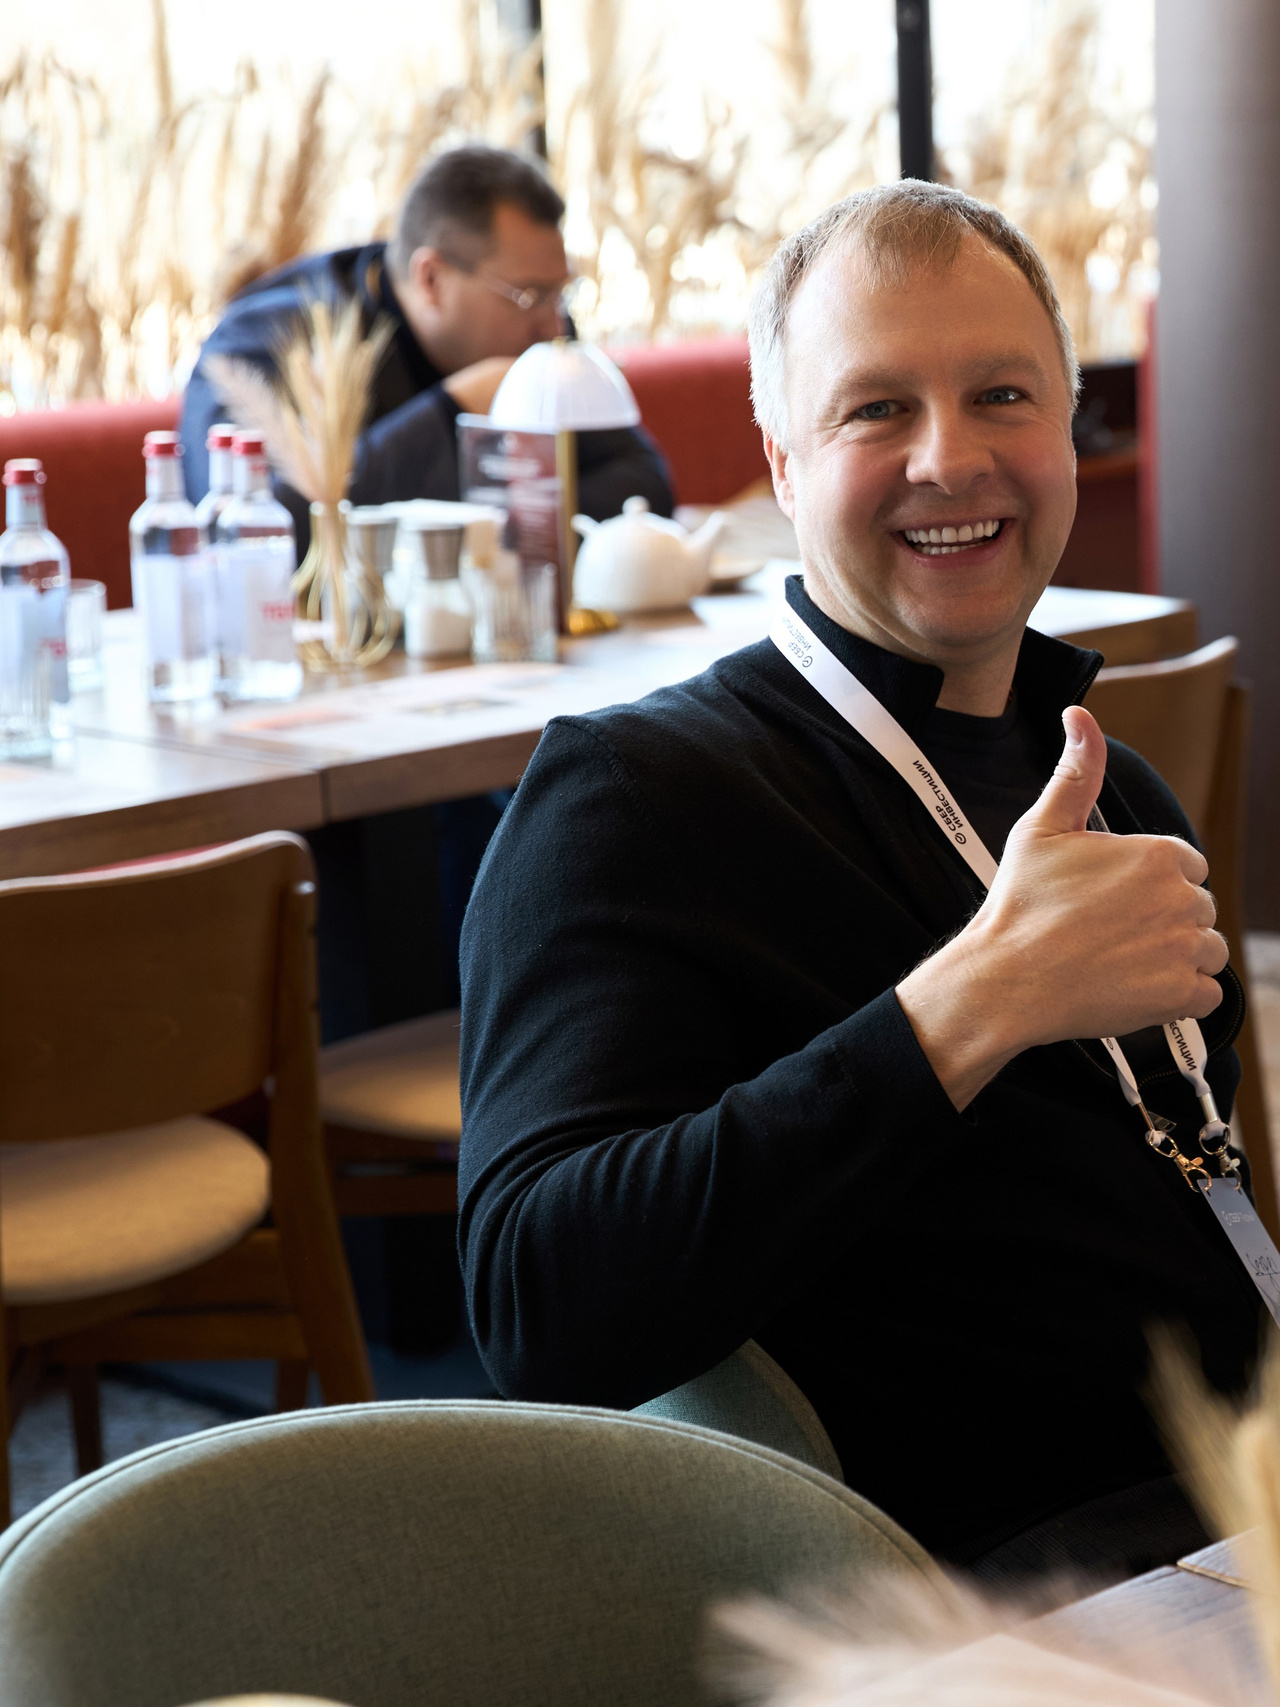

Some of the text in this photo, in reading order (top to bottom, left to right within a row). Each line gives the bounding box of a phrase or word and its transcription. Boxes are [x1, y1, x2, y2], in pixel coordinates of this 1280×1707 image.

[912, 759, 964, 829] ИНВЕСТИЦИИ
[935, 805, 958, 832] СБЕР
[1168, 1019, 1197, 1072] ЕСТИЦИИ
